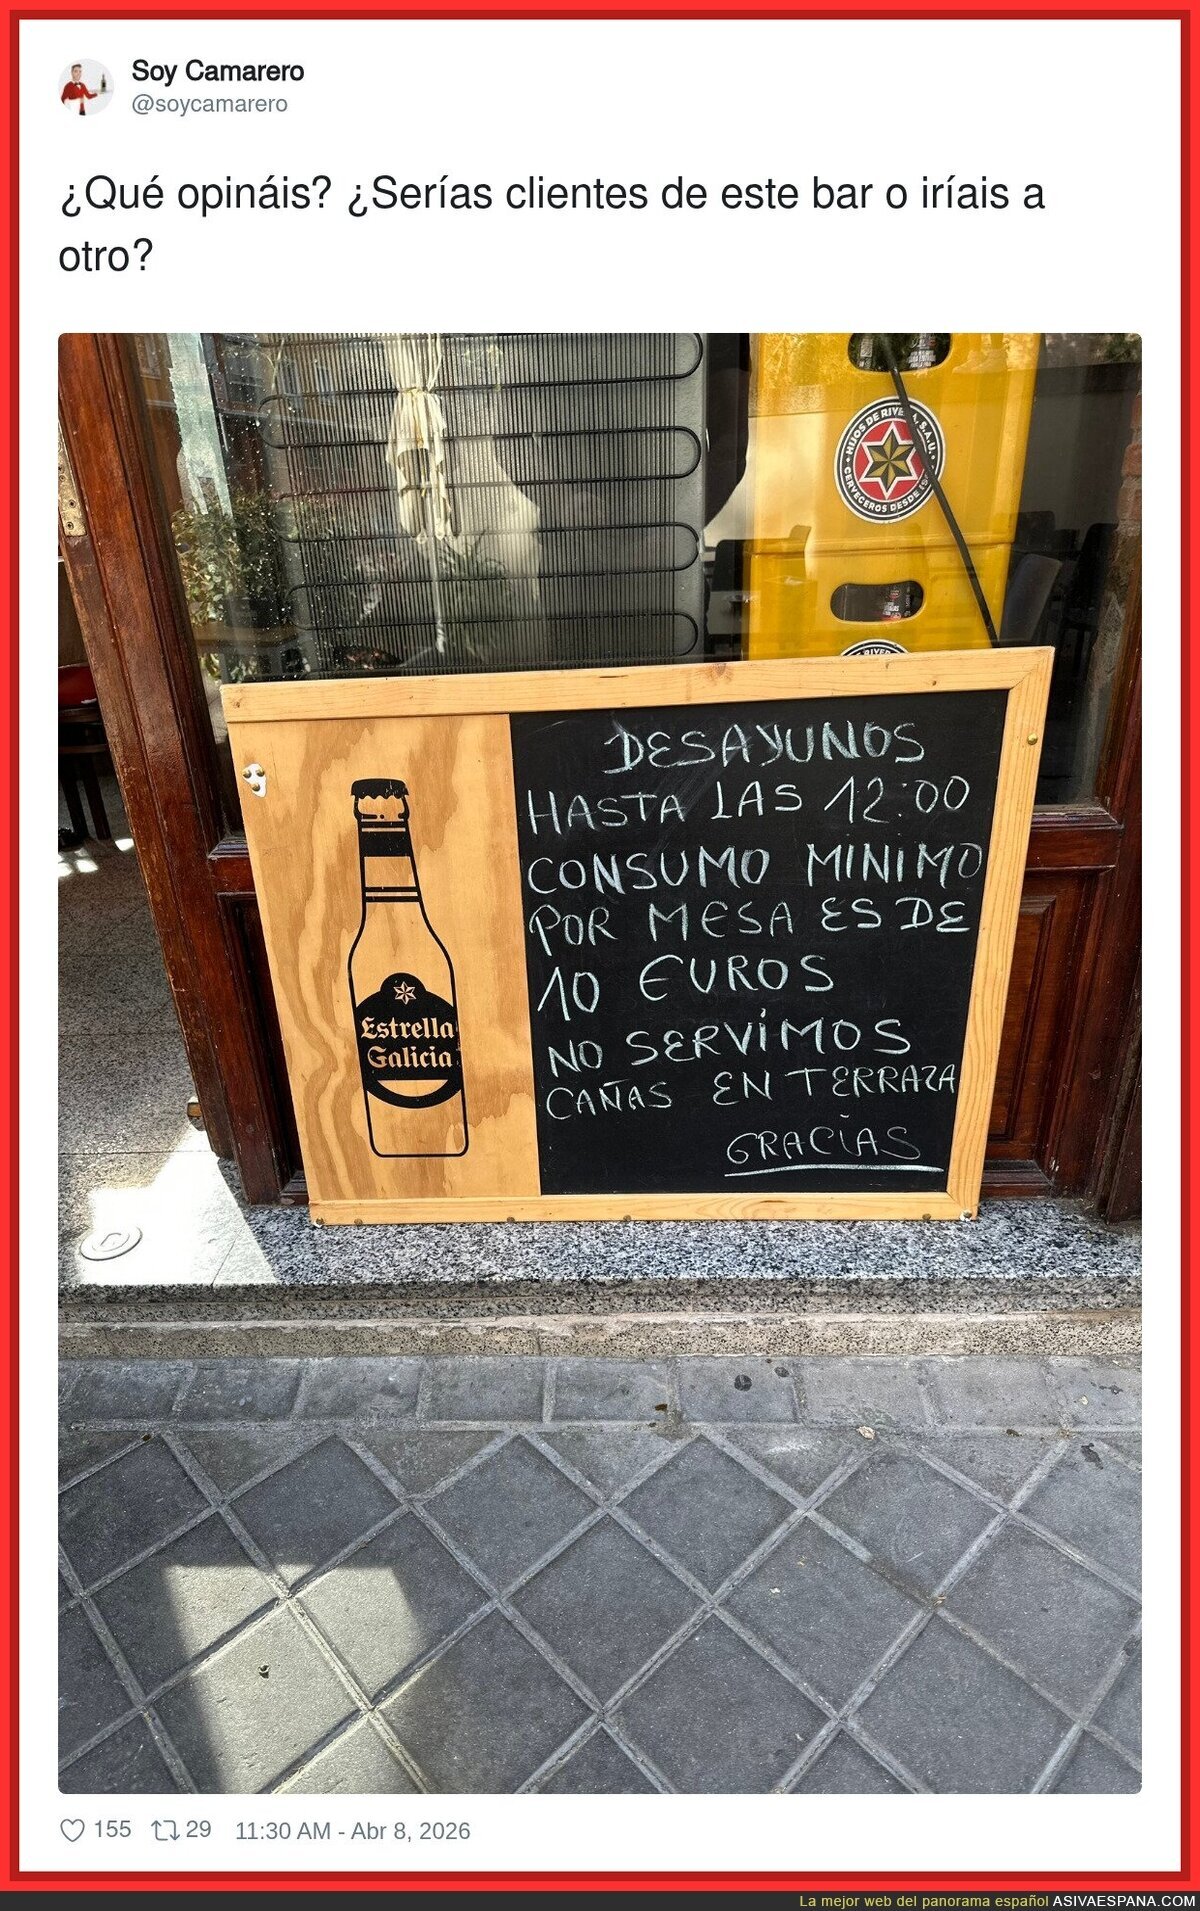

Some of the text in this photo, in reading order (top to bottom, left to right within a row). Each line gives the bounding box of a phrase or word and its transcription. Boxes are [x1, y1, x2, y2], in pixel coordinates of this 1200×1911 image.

[846, 424, 867, 455] HIJOS
[866, 412, 880, 426] DE
[919, 422, 937, 455] S.A.U.
[844, 466, 888, 513] CERVECEROS
[890, 491, 920, 512] DESDE
[602, 720, 925, 775] DESAYUNOS
[527, 775, 970, 836] HASTA LAS 12:00
[527, 845, 771, 896] CONSUMO
[528, 896, 971, 958] POR MESA ES DE
[536, 954, 835, 1022] 10 EUROS
[360, 1016, 456, 1040] Estrella
[367, 1045, 454, 1069] Galicia
[547, 1038, 603, 1078] NO
[546, 1063, 957, 1121] CAÑAS EN TERRAZA
